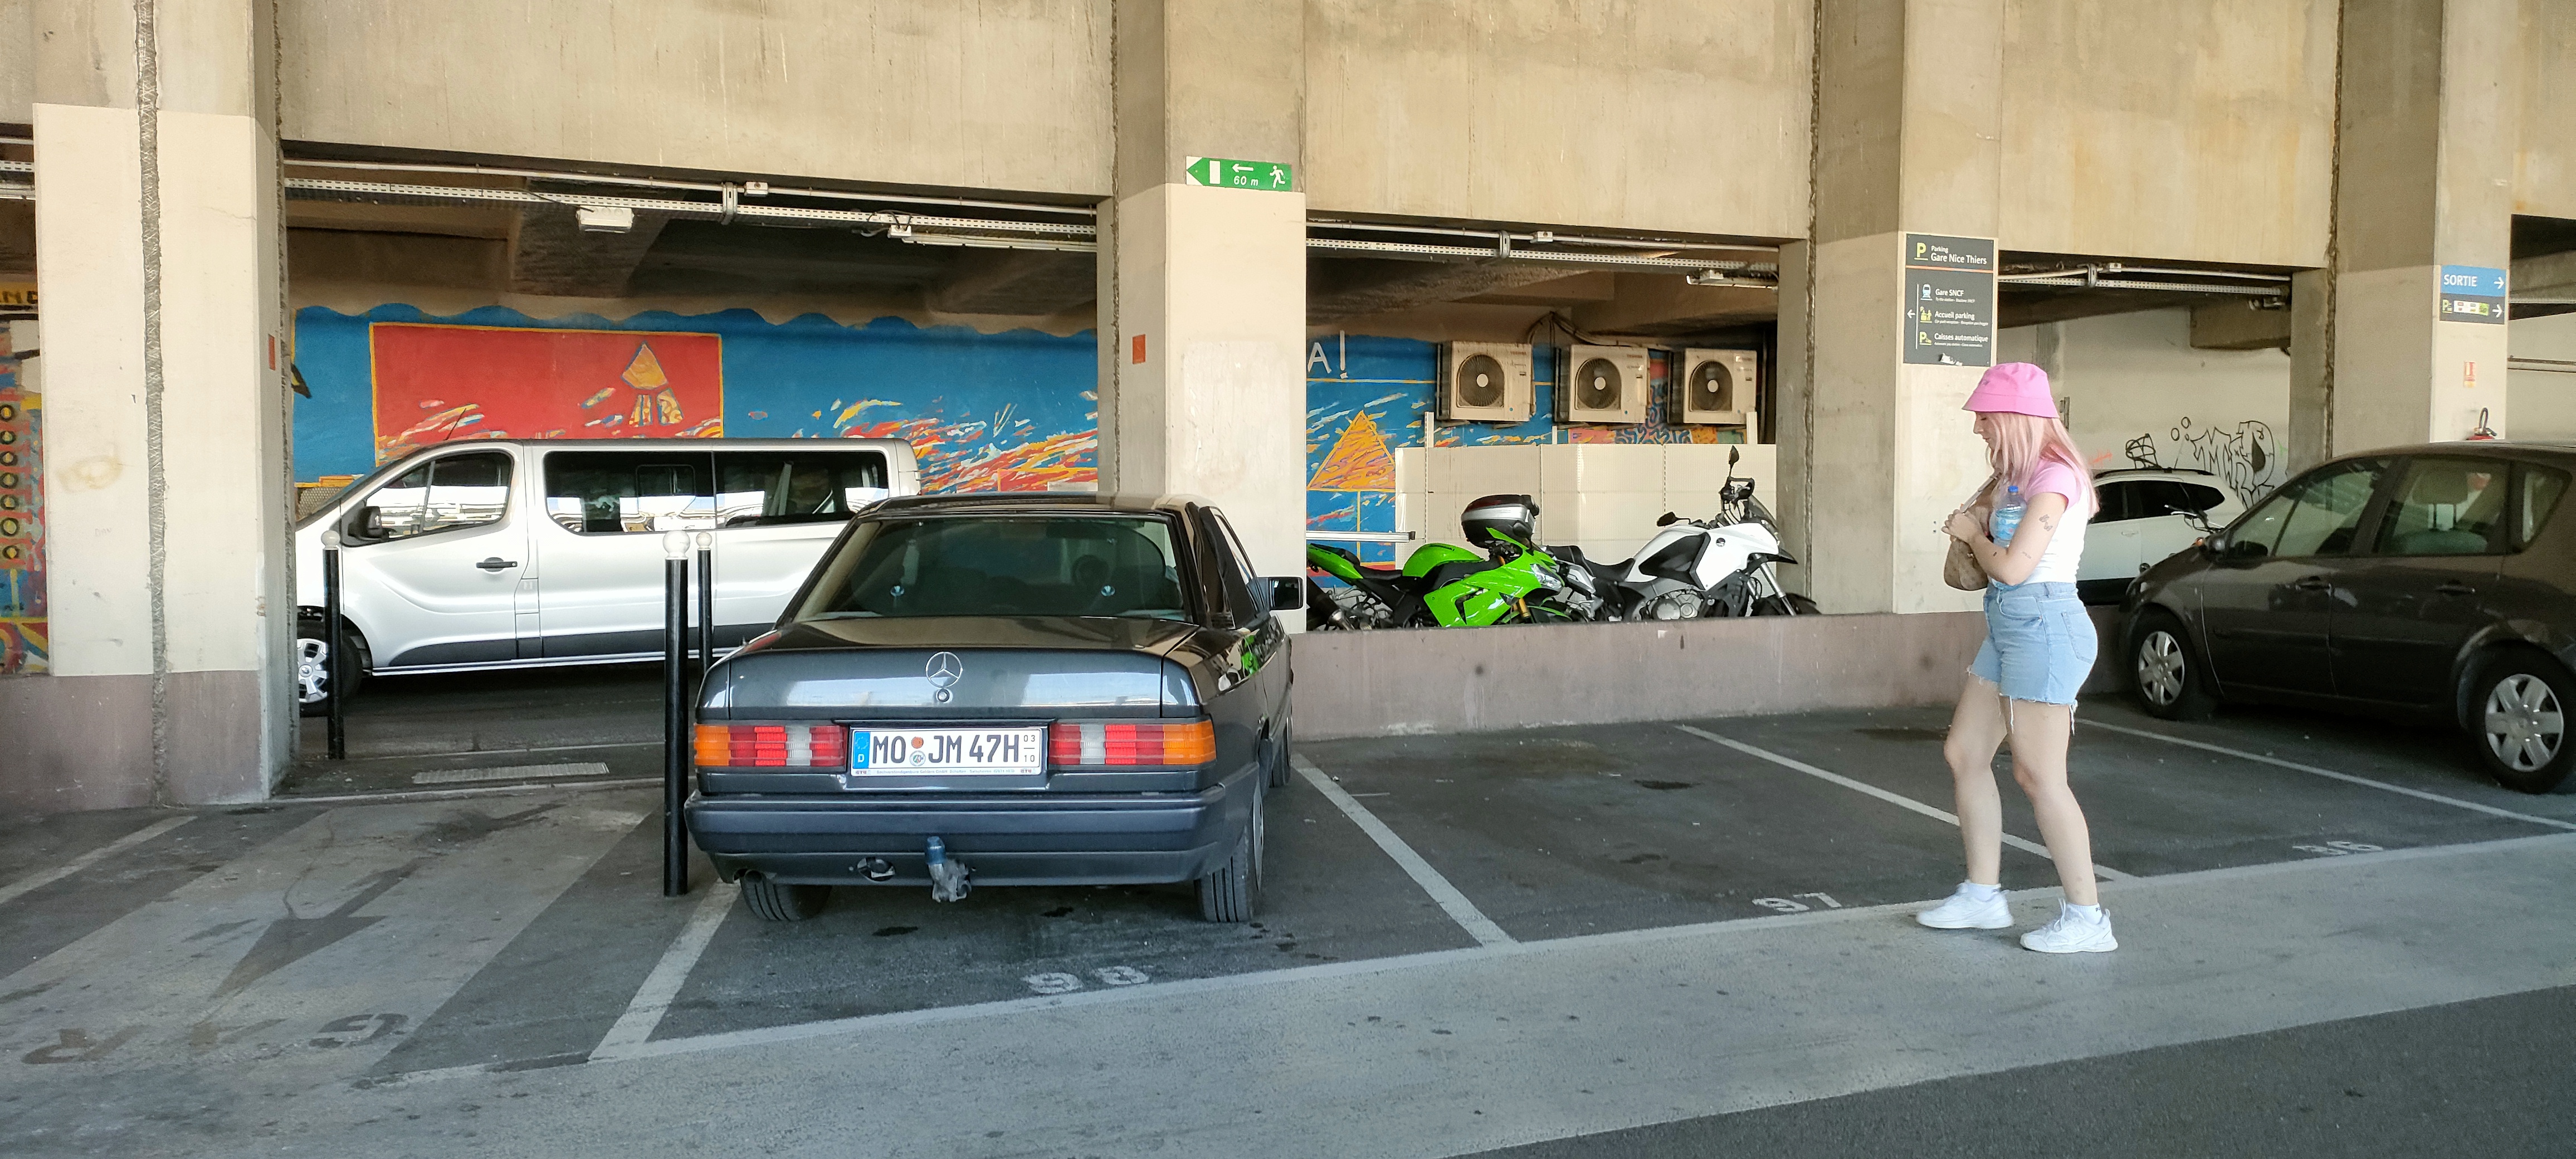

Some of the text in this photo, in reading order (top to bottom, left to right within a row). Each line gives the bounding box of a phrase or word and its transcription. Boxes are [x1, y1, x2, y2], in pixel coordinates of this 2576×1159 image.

[1233, 176, 1247, 186] 60
[1931, 245, 1949, 254] Parking
[1930, 252, 1987, 265] Gare Nice Thiers
[2443, 274, 2478, 287] SORTIE
[1949, 289, 1964, 297] SNCF
[1955, 311, 1975, 321] parking
[1954, 334, 1988, 343] automatique
[872, 734, 1019, 764] MO JM 47H
[857, 753, 865, 763] D
[1752, 892, 1842, 912] 97
